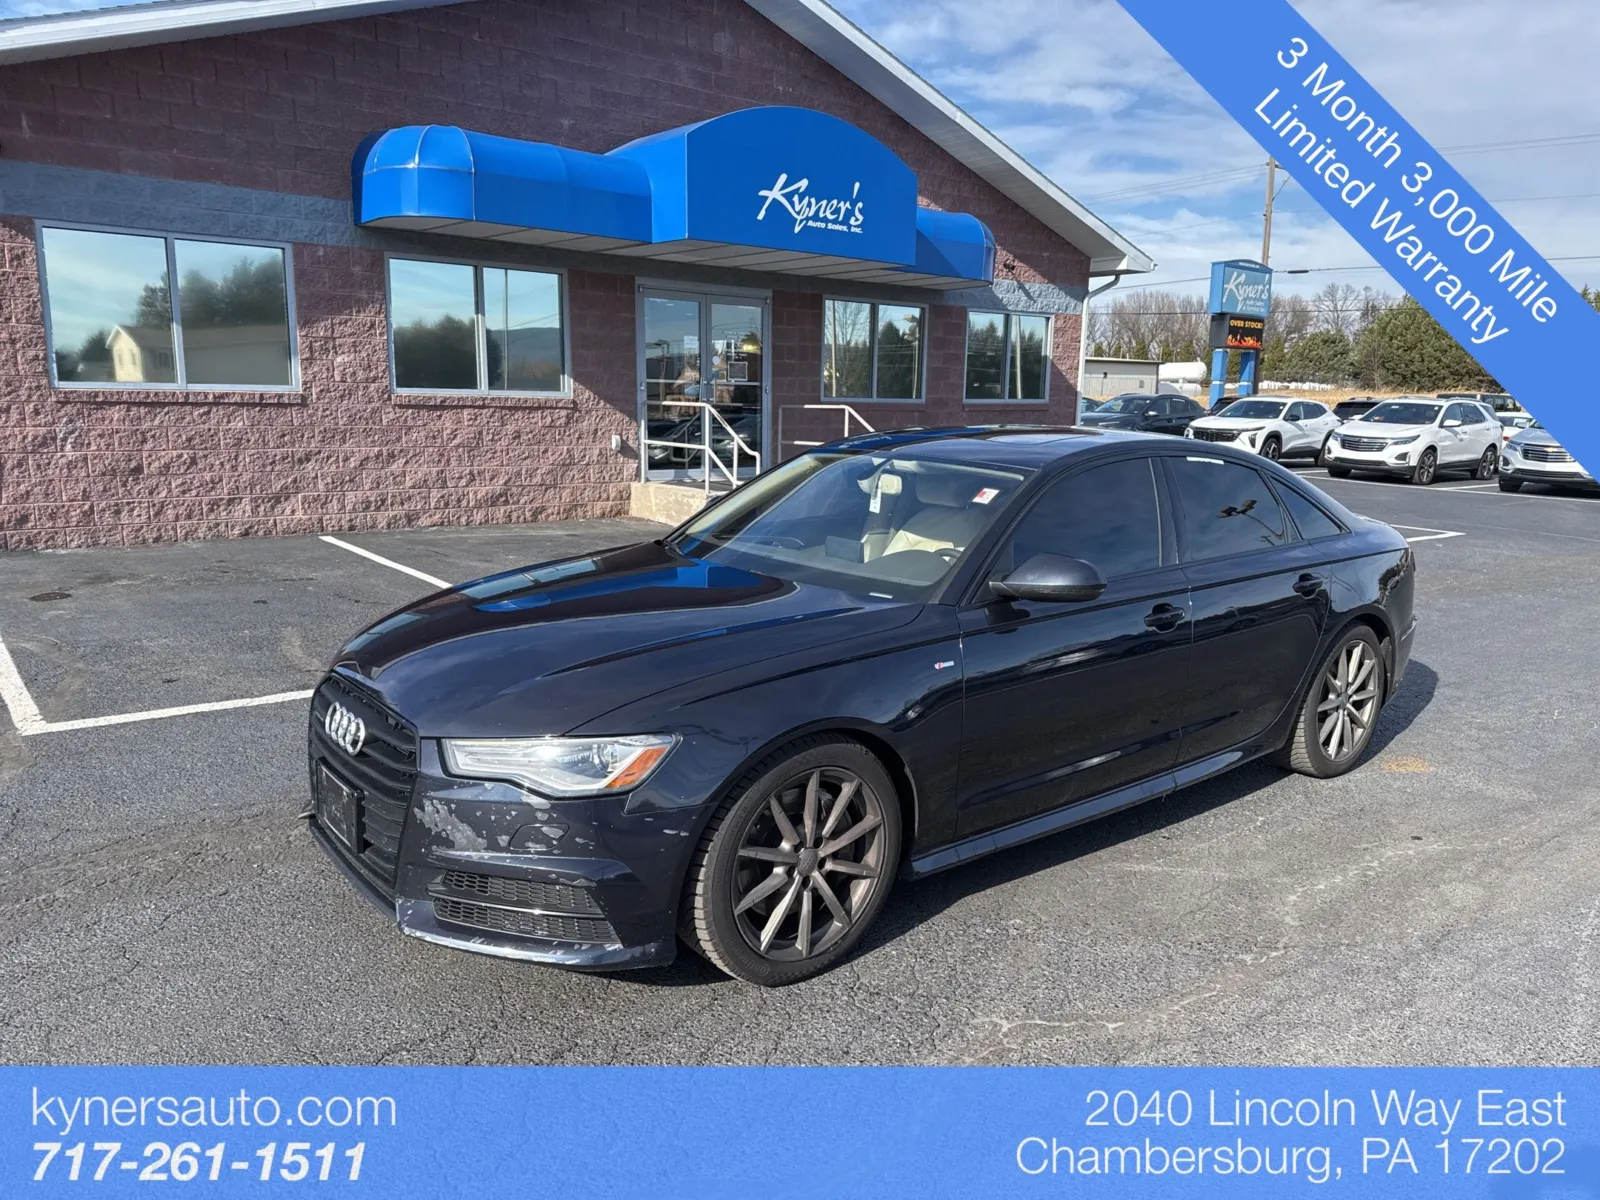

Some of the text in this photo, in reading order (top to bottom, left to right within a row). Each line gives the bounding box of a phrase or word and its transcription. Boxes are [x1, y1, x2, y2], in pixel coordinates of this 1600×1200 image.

[757, 173, 864, 234] Kyner's
[807, 220, 826, 229] Auto
[1223, 271, 1270, 312] Kyner's
[1229, 319, 1245, 327] OVER
